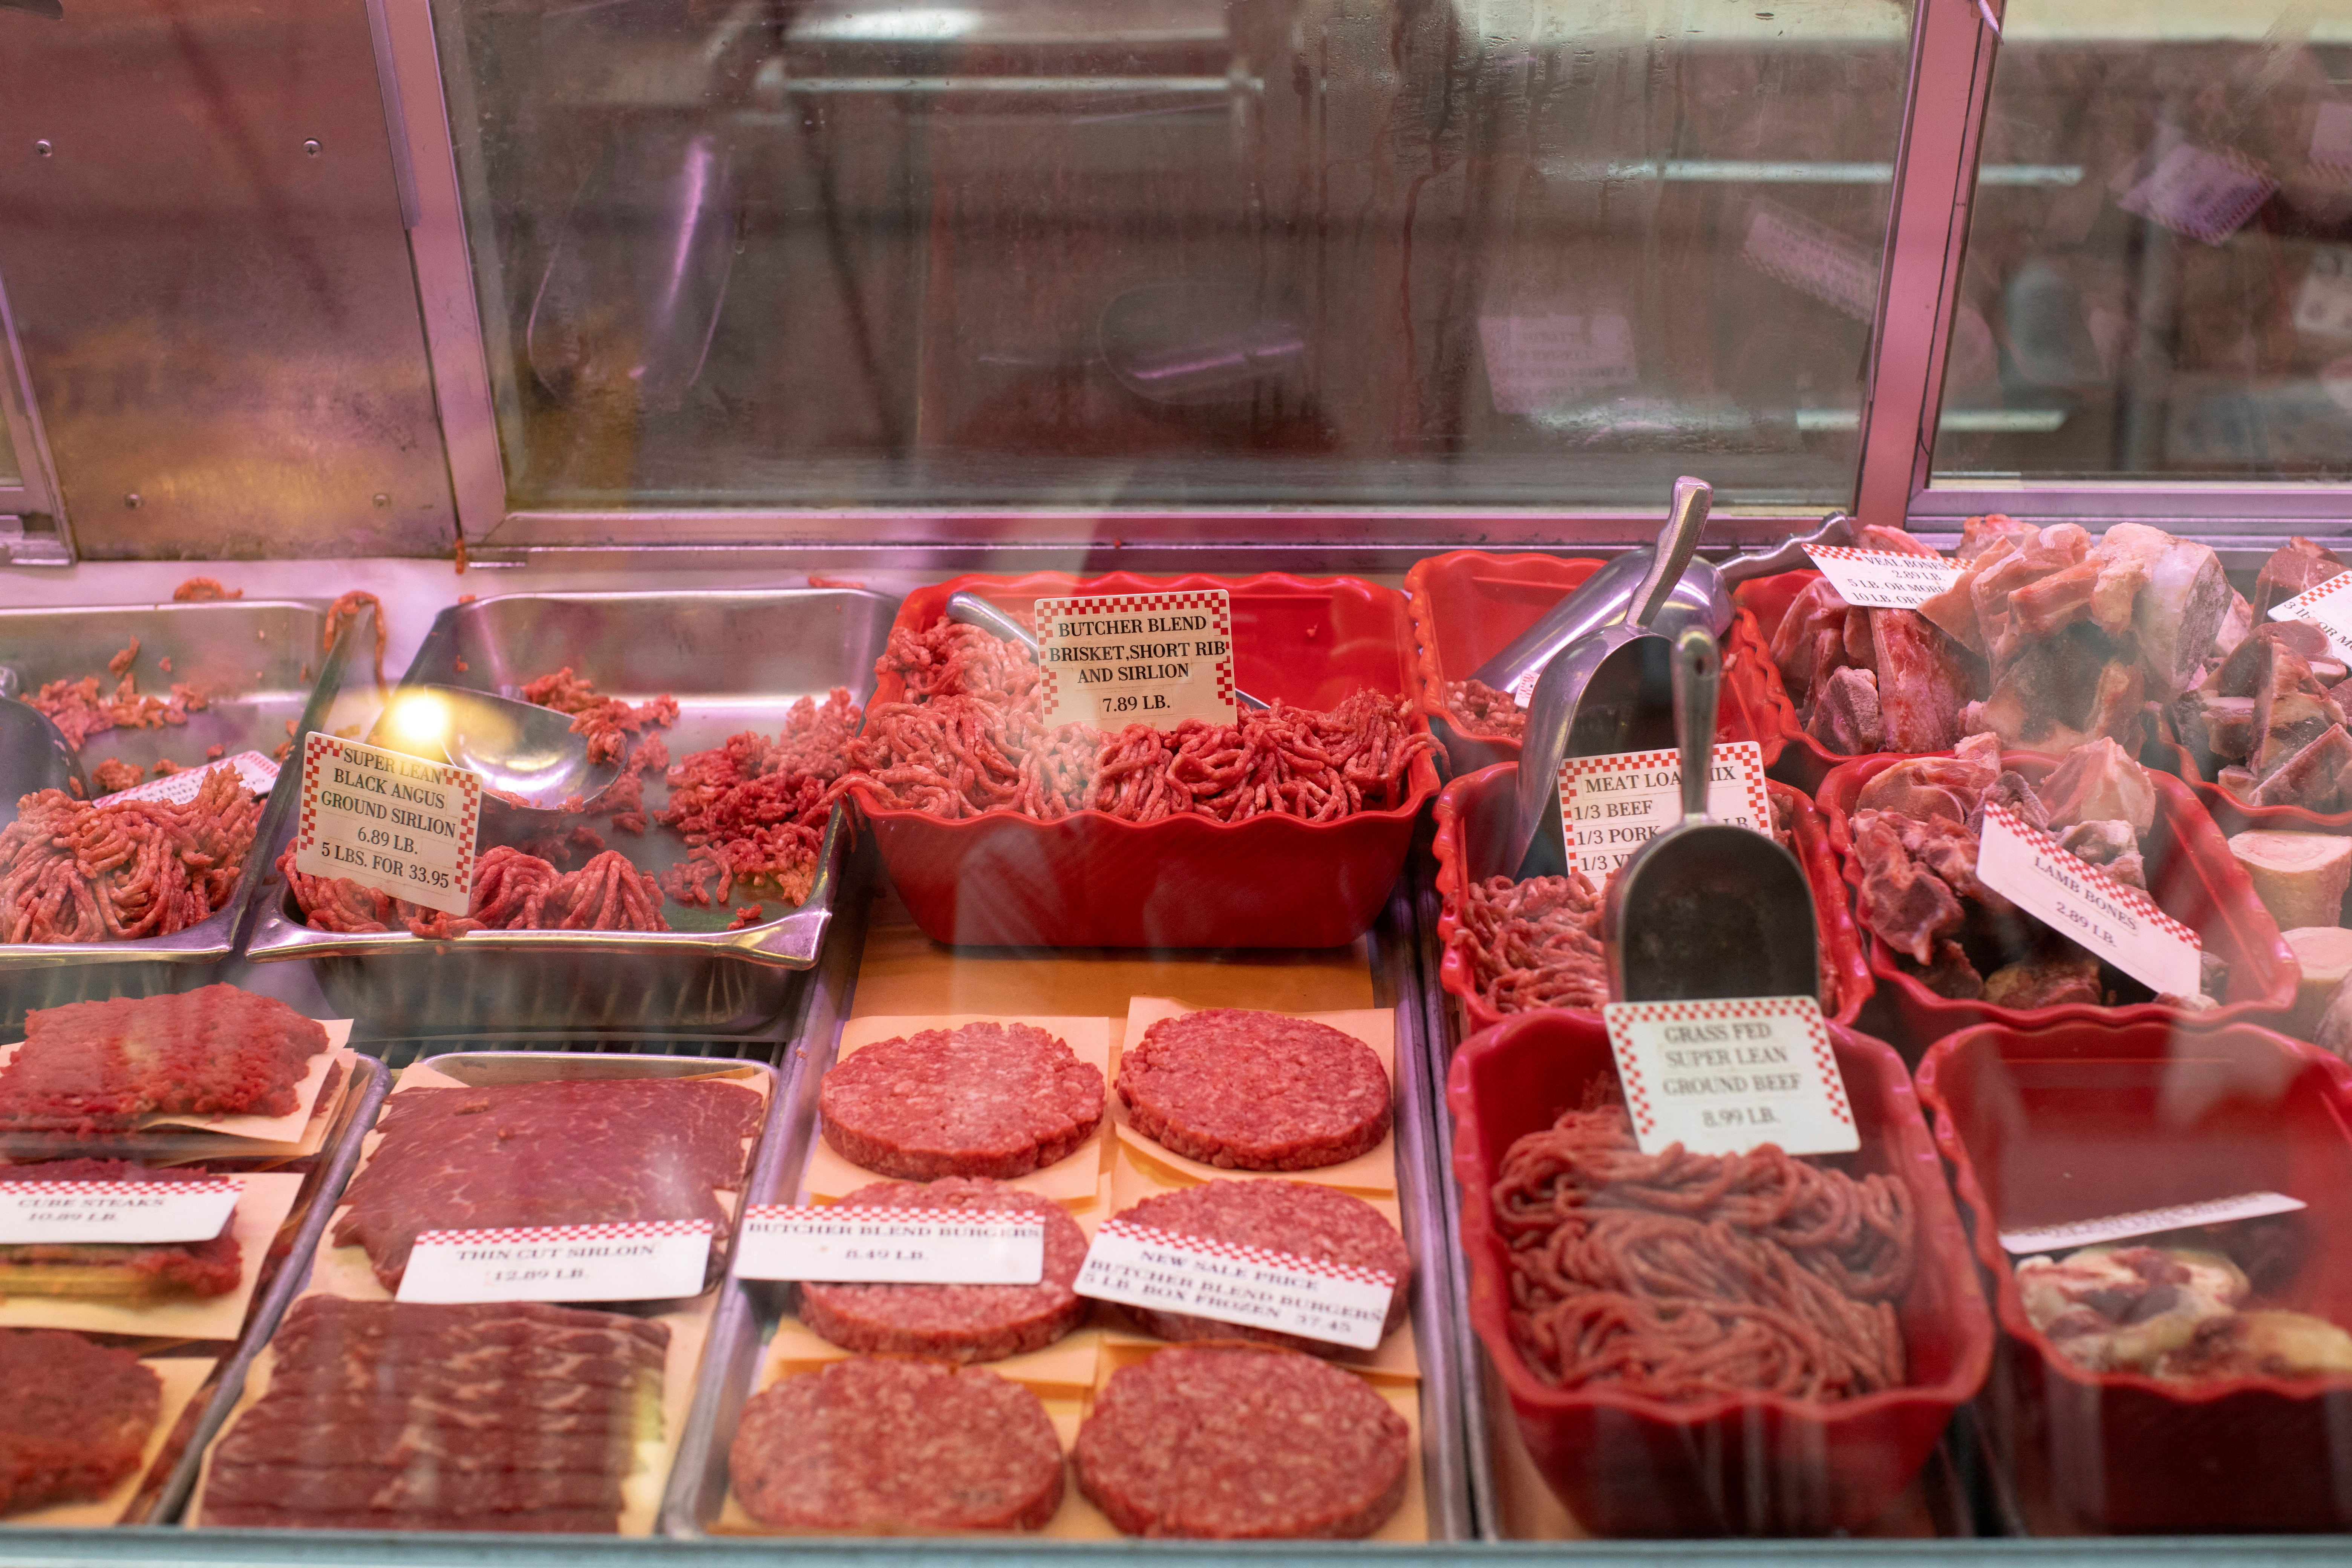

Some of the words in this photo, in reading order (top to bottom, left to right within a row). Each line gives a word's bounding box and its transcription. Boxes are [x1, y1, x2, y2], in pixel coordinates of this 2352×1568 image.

[1865, 556, 1902, 567] VEAL
[1903, 559, 1949, 570] BONES
[1858, 580, 1883, 589] LB.
[1885, 582, 1907, 591] OR
[1892, 570, 1920, 579] 2.89
[1922, 573, 1946, 581] LB.
[1851, 593, 1869, 601] 10
[1869, 594, 1895, 603] LB.
[1058, 619, 1143, 637] BUTCHER
[1148, 616, 1207, 632] BLEND
[2319, 622, 2337, 636] OR
[1195, 641, 1226, 656] RIB
[1078, 668, 1113, 683] AND
[1118, 663, 1190, 681] SIRLION
[1103, 697, 1138, 713] 7.89
[1143, 695, 1170, 710] LB.
[344, 747, 395, 774] SUPER
[400, 761, 443, 785] LEAN
[334, 768, 388, 795] BLACK
[391, 783, 445, 809] ANGUS
[1585, 775, 1639, 793] MEAT
[1644, 771, 1682, 787] LOA
[321, 791, 387, 819] GROUND
[391, 808, 456, 838] SIRLION
[1574, 805, 1601, 820] 1/3
[1606, 801, 1652, 817] BEEF
[358, 827, 390, 847] 6.89
[393, 835, 418, 855] LB.
[1577, 830, 1603, 845] 1/3
[1608, 826, 1660, 843] PORK
[322, 842, 330, 856] 5
[335, 845, 367, 868] LBS.
[372, 855, 404, 877] FOR
[409, 865, 449, 888] 33.95
[1581, 856, 1608, 871] 1/3
[2035, 857, 2079, 893] LAMB
[2085, 889, 2137, 929] BONES
[2056, 902, 2088, 927] 2.89
[2093, 924, 2117, 947] LB.
[1663, 1024, 1728, 1044] GRASS
[1733, 1022, 1772, 1039] FED
[1665, 1049, 1732, 1068] SUPER
[1735, 1046, 1788, 1065] LEAN
[1663, 1075, 1748, 1095] GROUND
[1754, 1073, 1801, 1091] BEEF
[1702, 1109, 1743, 1128] 8.99
[18, 1198, 77, 1208] CUBE
[81, 1198, 166, 1208] STEAKS
[749, 1223, 851, 1235] BUTCHER
[860, 1225, 931, 1237] BLEND
[940, 1227, 1039, 1238] BURGERS
[458, 1249, 511, 1261] THIN
[516, 1247, 563, 1260] CUT
[567, 1245, 655, 1259] SIRLOIN
[1140, 1250, 1188, 1267] NEW
[1193, 1261, 1245, 1278] SALE
[1254, 1270, 1318, 1290] PRICE
[1089, 1260, 1193, 1288] BUTCHER
[1200, 1281, 1274, 1302] BLEND
[1280, 1295, 1383, 1322] BURGERS
[1143, 1284, 1190, 1302] BOX
[1195, 1294, 1281, 1319] FROZEN
